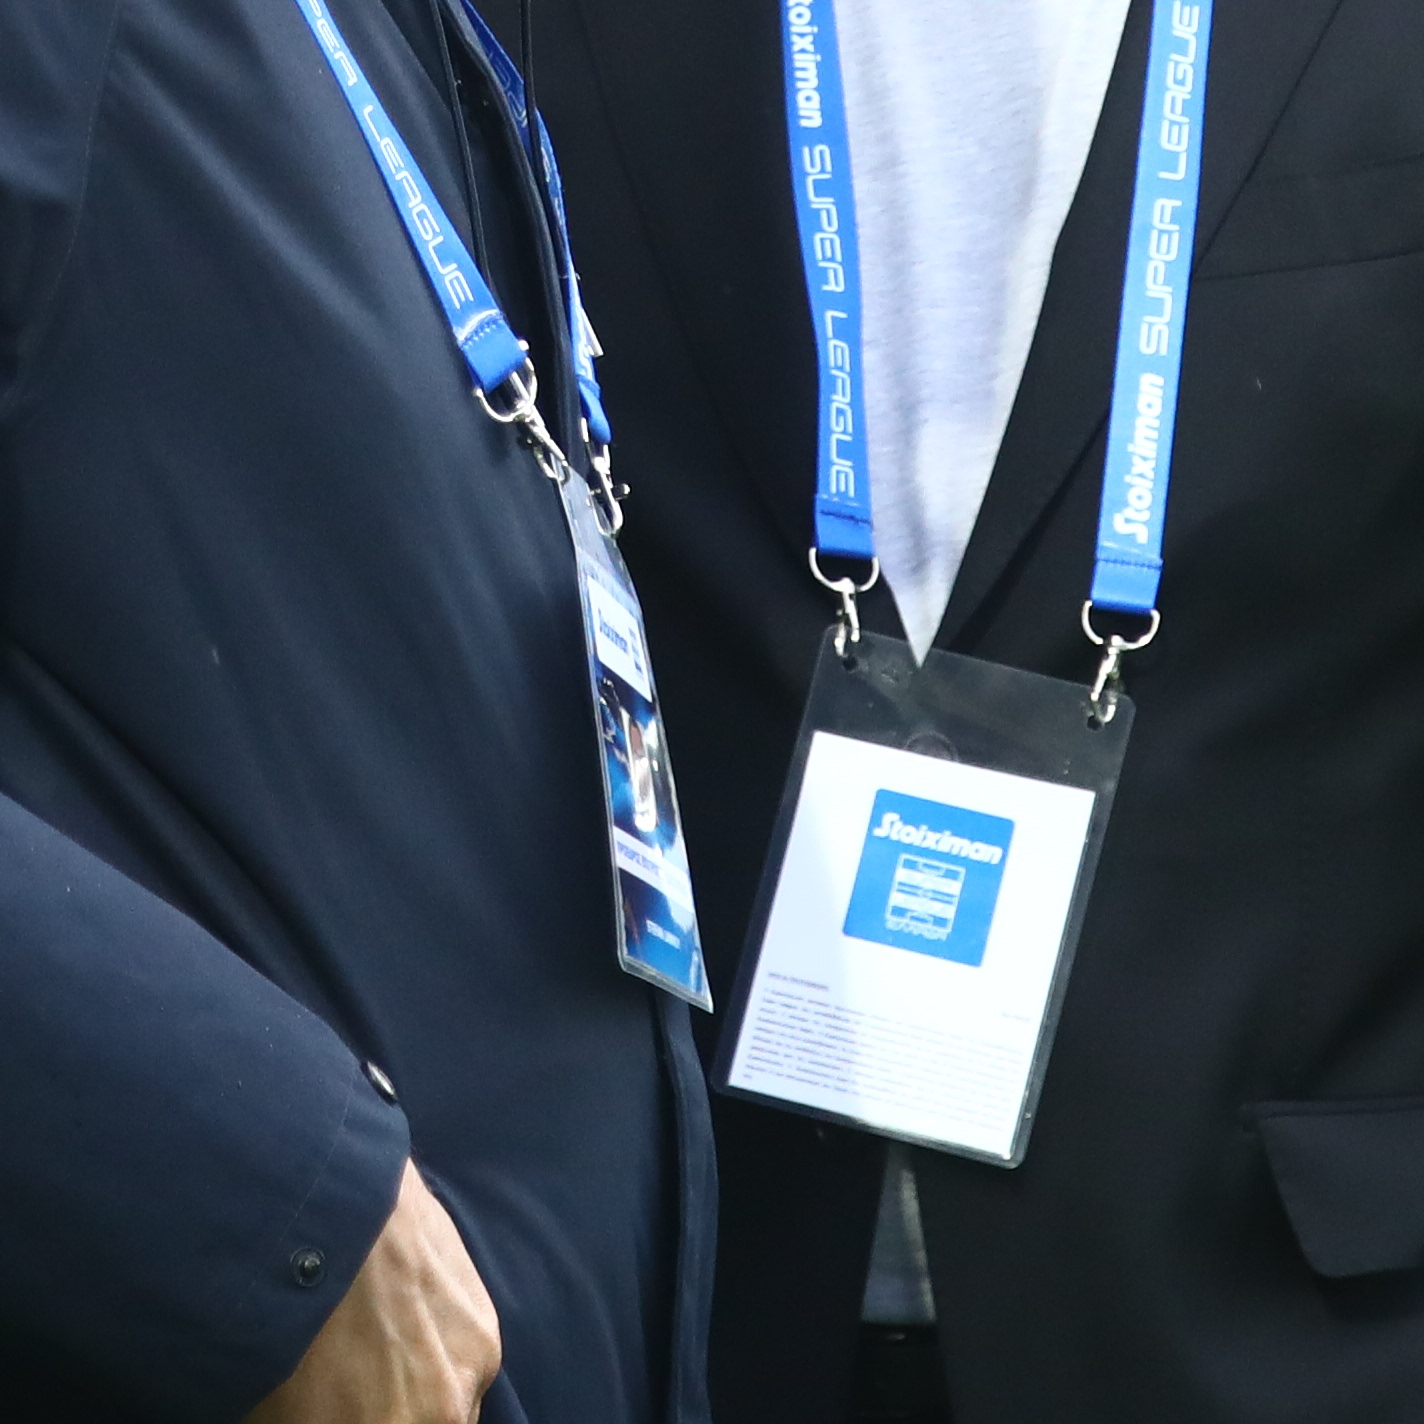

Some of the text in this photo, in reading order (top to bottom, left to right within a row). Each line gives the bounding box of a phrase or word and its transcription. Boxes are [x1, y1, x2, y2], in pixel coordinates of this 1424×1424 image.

[1158, 0, 1200, 181] LEAGUE
[360, 102, 475, 311] LEAGUE
[803, 144, 844, 294] SUPER
[1137, 198, 1183, 357] SUPER
[822, 309, 856, 501] LEAGUE
[1113, 373, 1165, 546] Stoiximan
[873, 811, 1004, 865] Stoiximan
